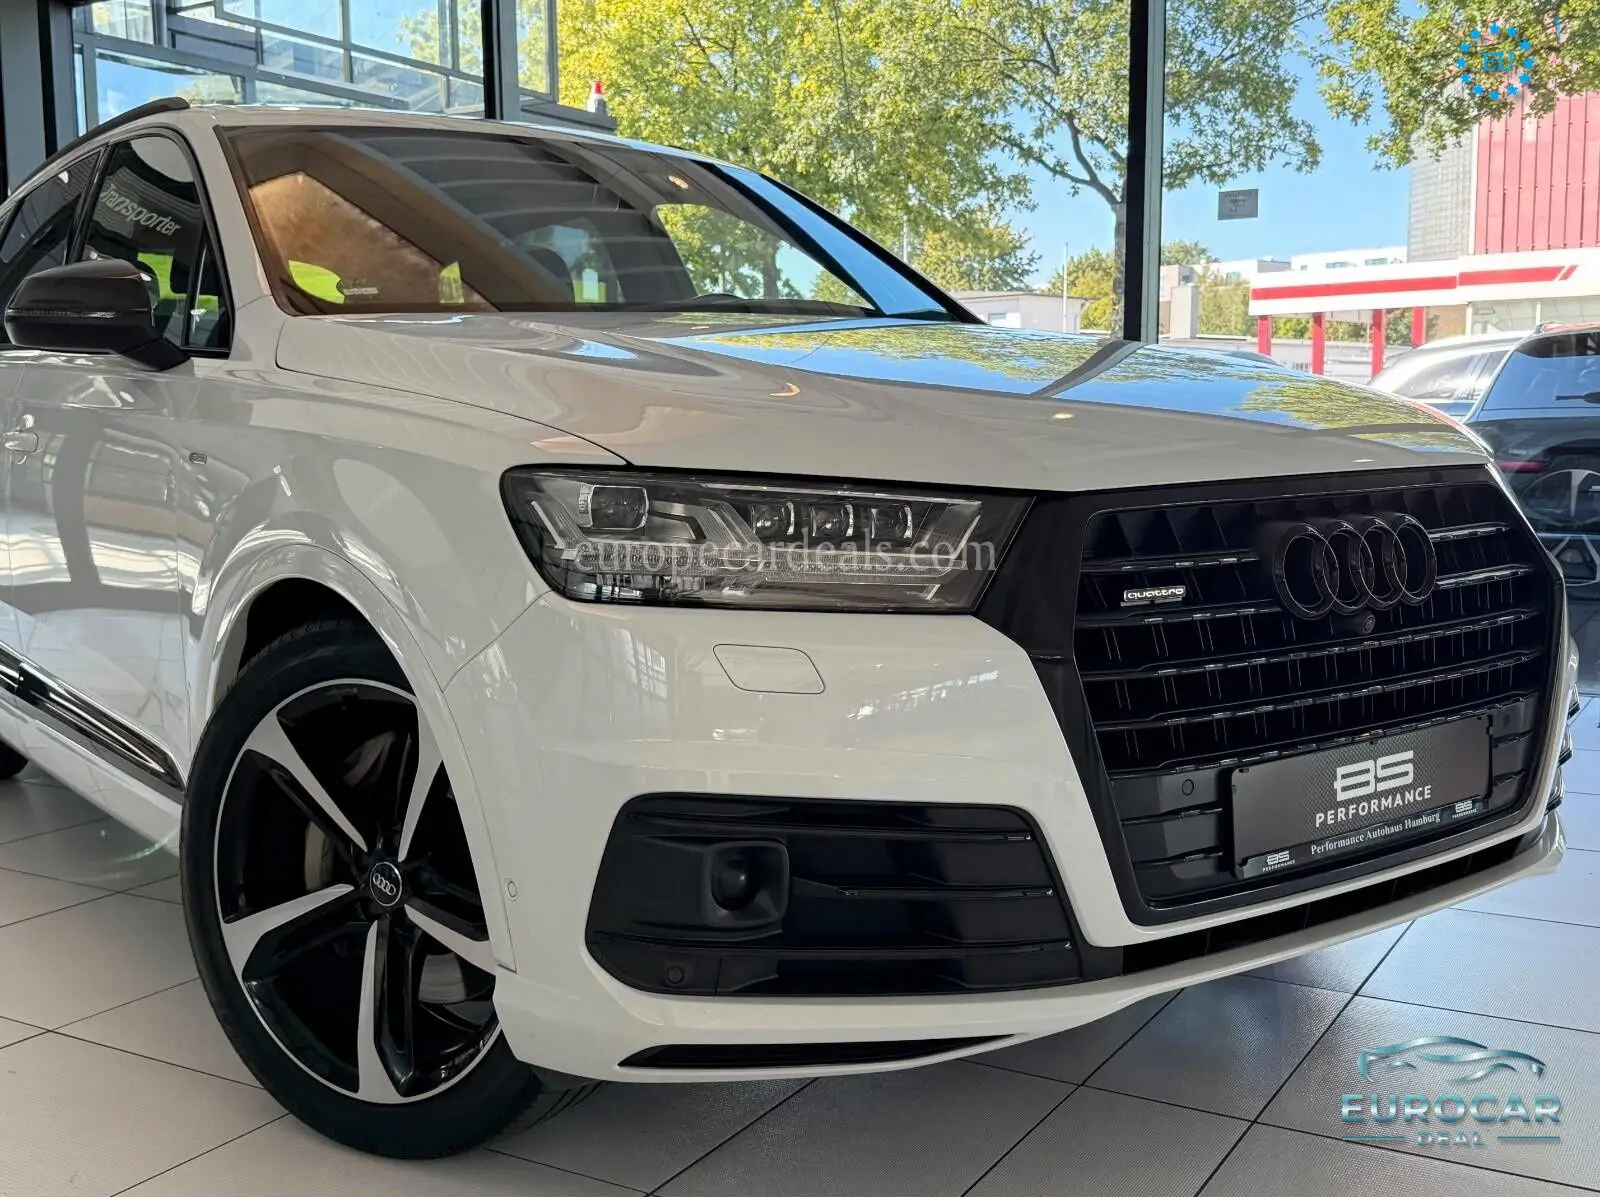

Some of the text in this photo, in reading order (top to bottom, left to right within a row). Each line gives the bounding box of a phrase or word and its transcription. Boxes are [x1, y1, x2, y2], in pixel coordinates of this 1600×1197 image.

[1127, 588, 1184, 600] quattro
[1315, 785, 1432, 828] PERFORMANCE
[1311, 812, 1441, 855] Performance Autohaus Hamburg
